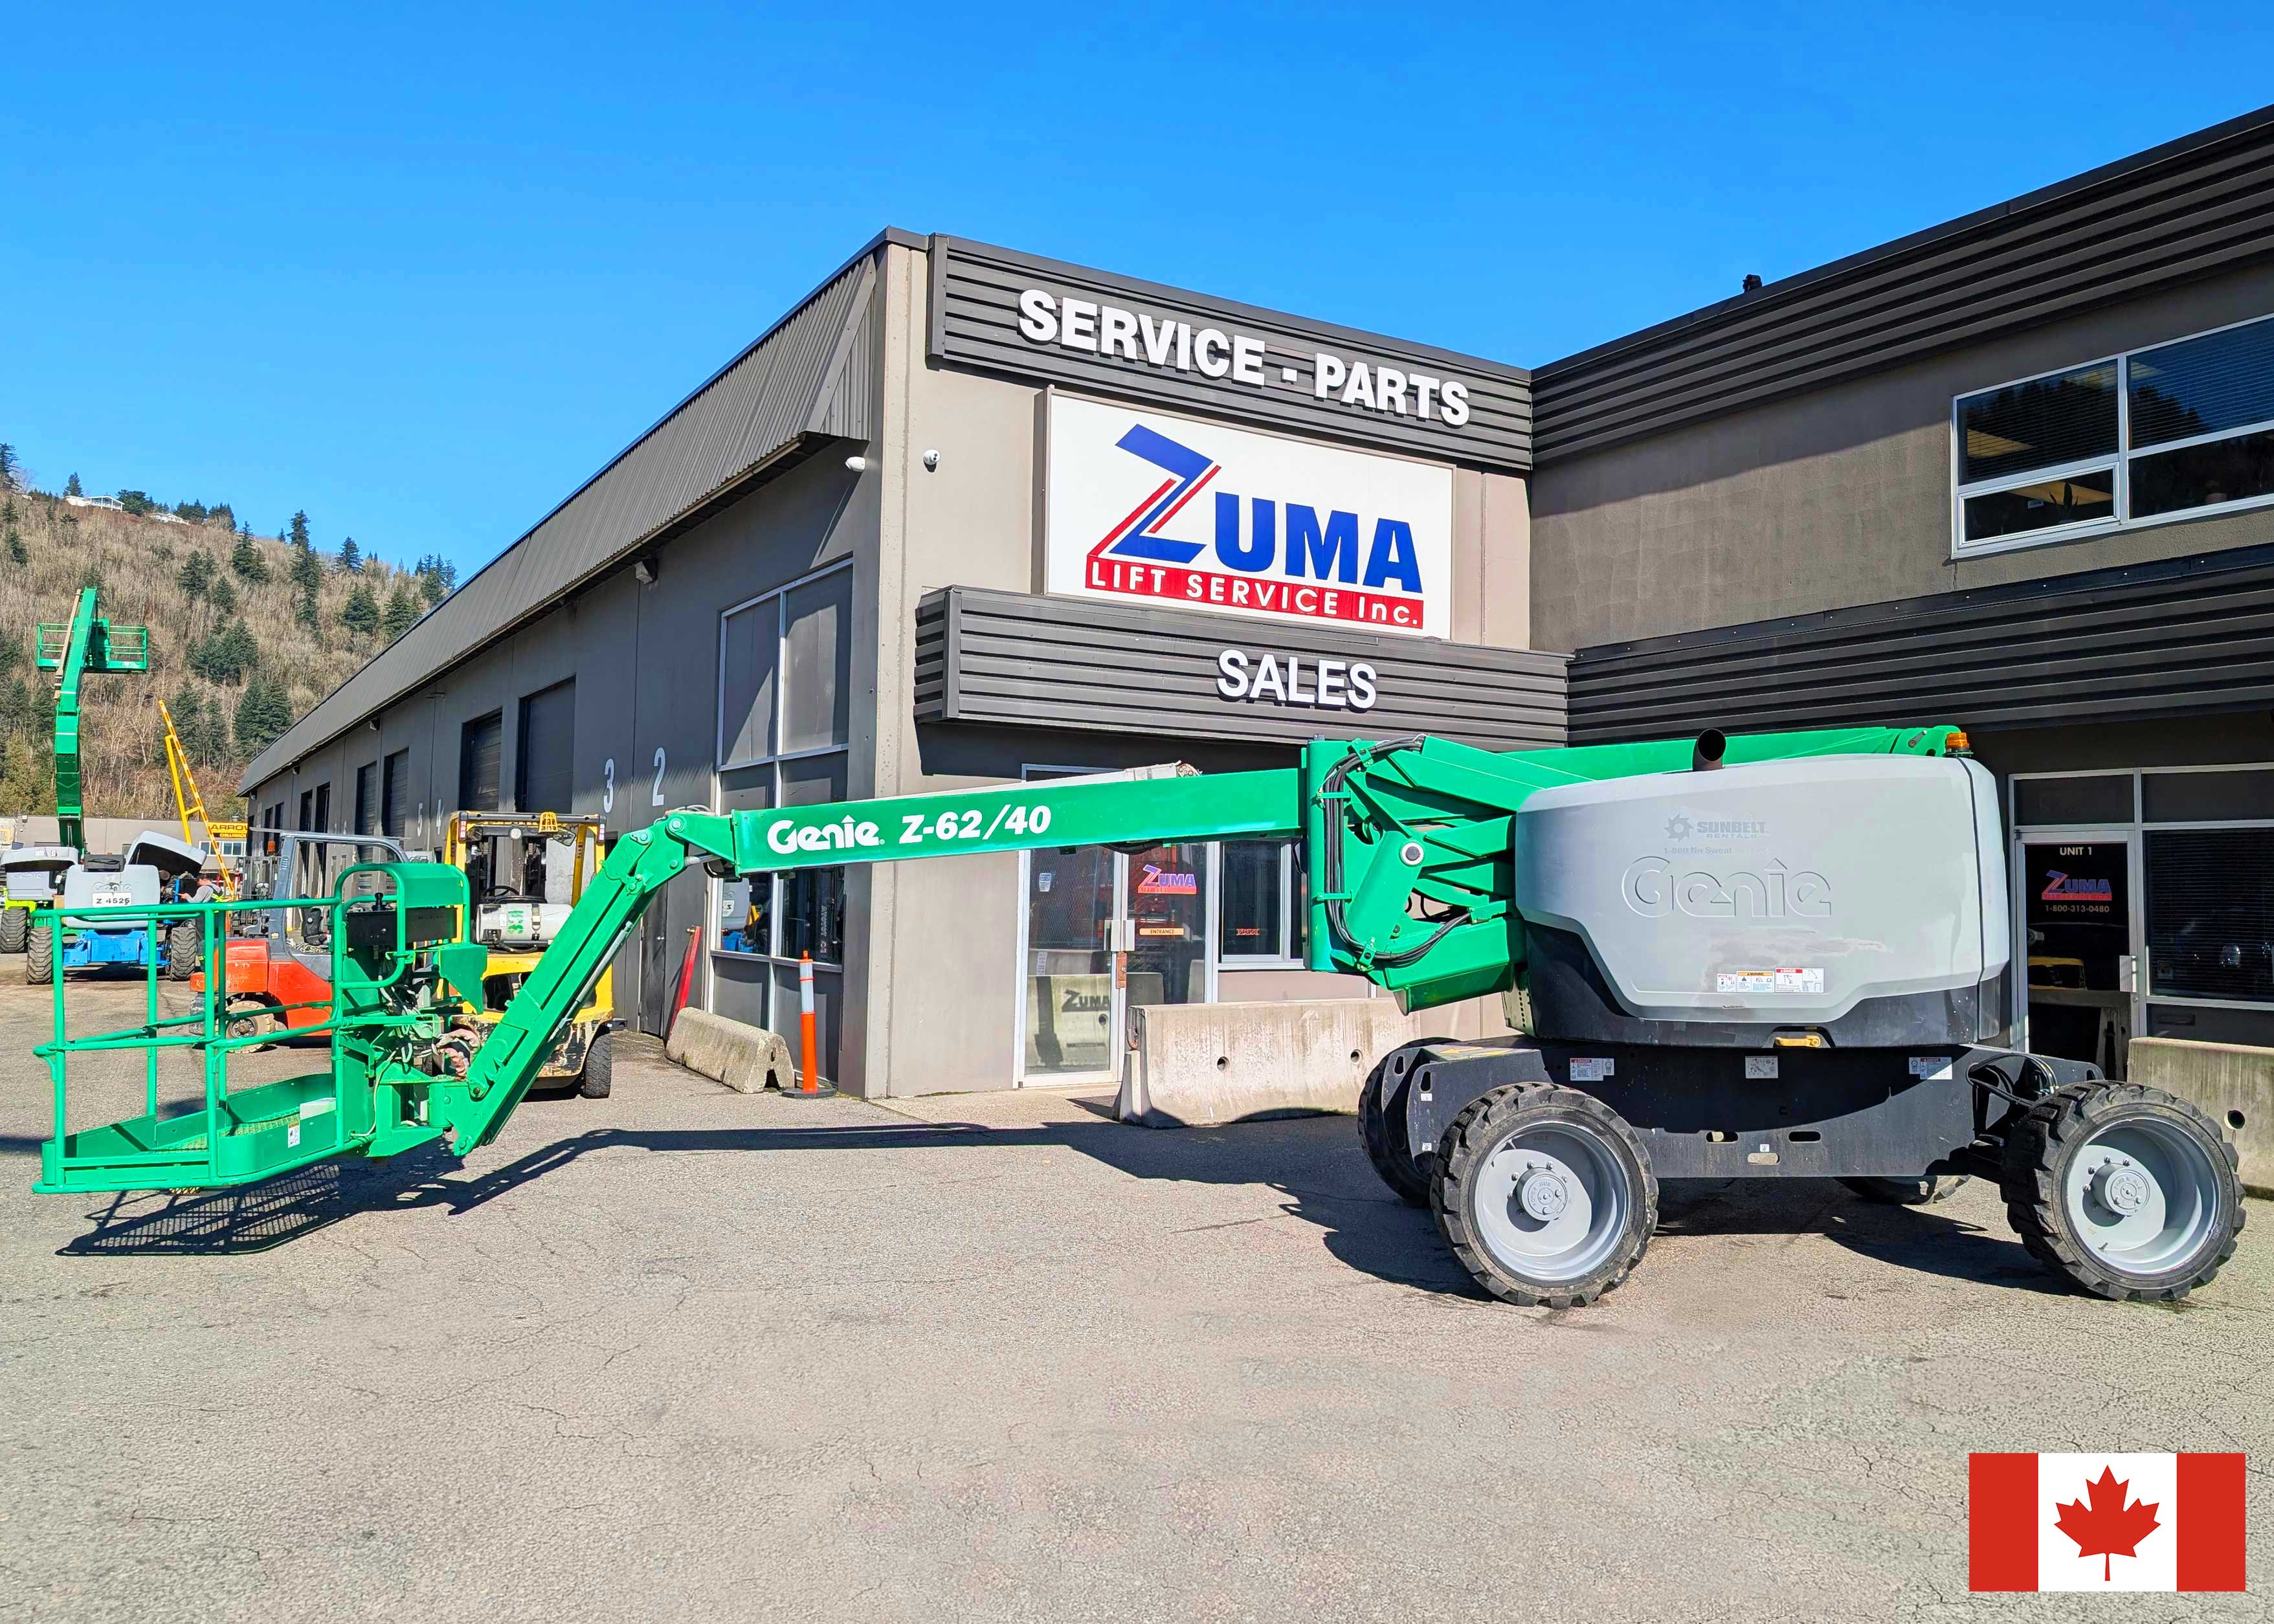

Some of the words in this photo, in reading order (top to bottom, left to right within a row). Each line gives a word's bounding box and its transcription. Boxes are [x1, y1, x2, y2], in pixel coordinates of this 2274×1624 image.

[1019, 289, 1265, 386] SERVICE
[1315, 352, 1469, 425] PARTS
[1088, 424, 1423, 593] ZUMA
[1091, 561, 1166, 592] LIFT
[1186, 573, 1338, 615] SERVICE
[1359, 596, 1418, 625] Inc.
[1217, 649, 1377, 709] SALES
[603, 758, 614, 813] 3
[652, 746, 666, 806] 2
[767, 814, 885, 854] Genie
[898, 804, 1052, 844] Z-62/40
[1697, 821, 1767, 834] SUNBELT
[2059, 847, 2084, 856] UNIT
[2088, 847, 2092, 856] 1
[1139, 864, 1196, 887] ZUMA
[1622, 856, 1831, 917] Genie
[2042, 869, 2112, 894] ZUMA
